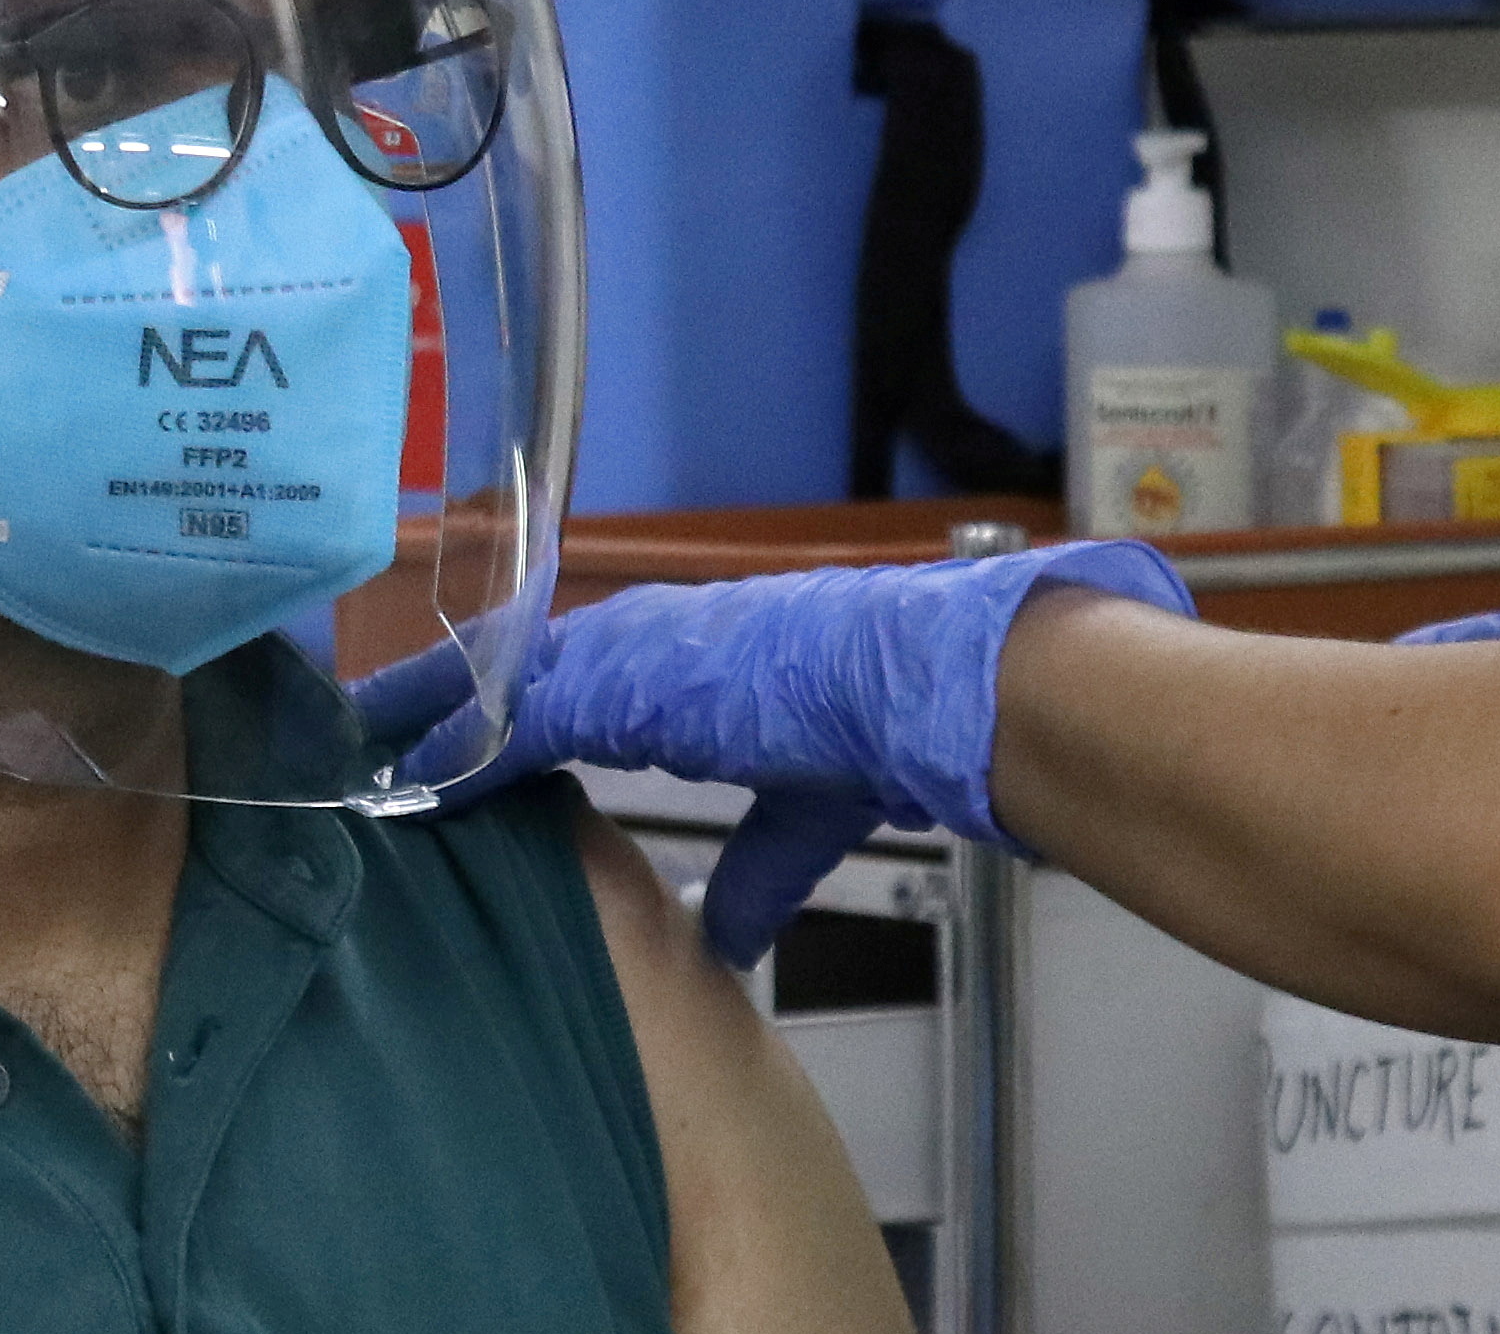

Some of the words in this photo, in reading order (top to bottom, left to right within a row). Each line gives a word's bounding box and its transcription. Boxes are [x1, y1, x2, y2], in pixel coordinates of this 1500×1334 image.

[138, 327, 290, 389] NEA
[197, 411, 271, 433] 32496
[183, 446, 248, 469] FFP2
[108, 479, 321, 501] EN149:2001+A1:2009
[185, 511, 245, 536] N95
[1264, 1043, 1492, 1154] UNCTURE
